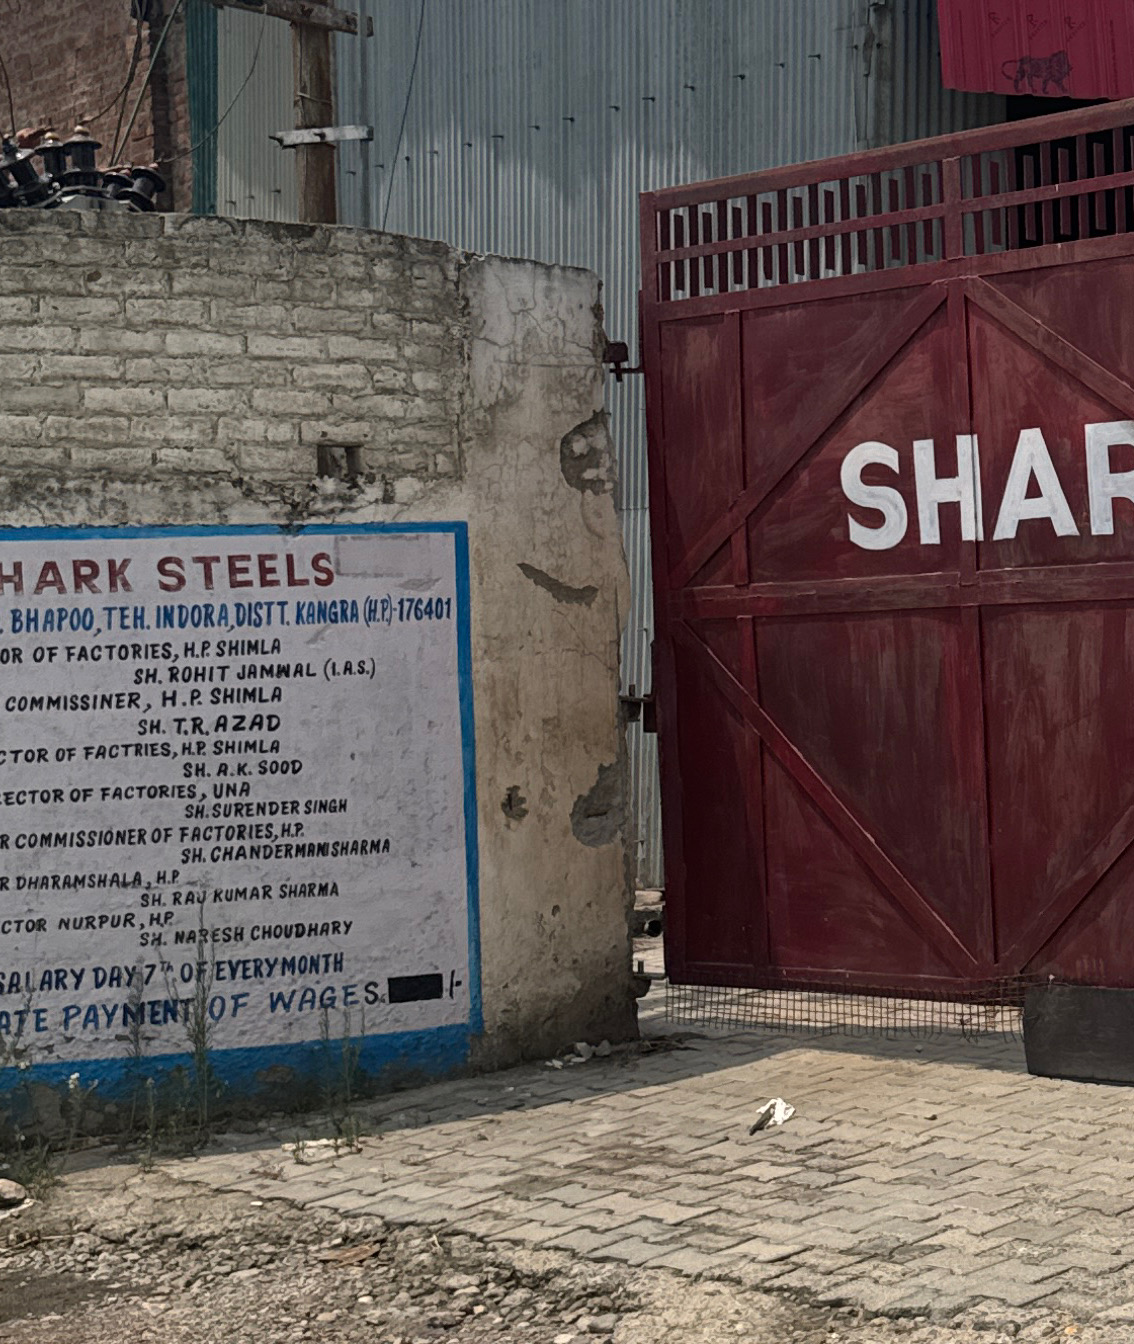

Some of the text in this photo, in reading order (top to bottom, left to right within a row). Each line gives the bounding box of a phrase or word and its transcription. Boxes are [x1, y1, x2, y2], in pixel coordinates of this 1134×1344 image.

[157, 552, 335, 593] STEELS
[295, 599, 359, 625] KANGRA
[33, 646, 58, 663] OF
[65, 642, 180, 662] FACTORIES,
[216, 638, 281, 657] SHIMLA
[133, 667, 163, 685] SH.
[168, 665, 230, 683] ROHIT
[236, 662, 317, 680] JAMWAL
[210, 686, 282, 706] SHIMLA
[138, 719, 167, 736] SH.
[214, 714, 281, 733] AZAD
[55, 747, 77, 763] OF
[83, 742, 178, 760] FACTRIES,
[212, 740, 280, 755] SHIMLA
[182, 762, 212, 778] SH.
[258, 759, 303, 775] SOOD
[0, 782, 251, 806] ECTOR OF FACTORIES, UNA
[304, 798, 348, 815] SINGH
[15, 828, 148, 849] COMMISSIONER
[151, 827, 173, 844] OF
[140, 893, 167, 908] SH.
[213, 885, 272, 903] KUMAR
[279, 882, 340, 899] SHARMA
[140, 920, 353, 947] SH. NARESH CHOUDHARY
[92, 964, 137, 989] DAY
[180, 961, 208, 983] OF
[215, 957, 278, 981] EVERY
[281, 952, 344, 975] MONTH
[62, 998, 196, 1031] PAYMENT
[208, 992, 250, 1022] OF
